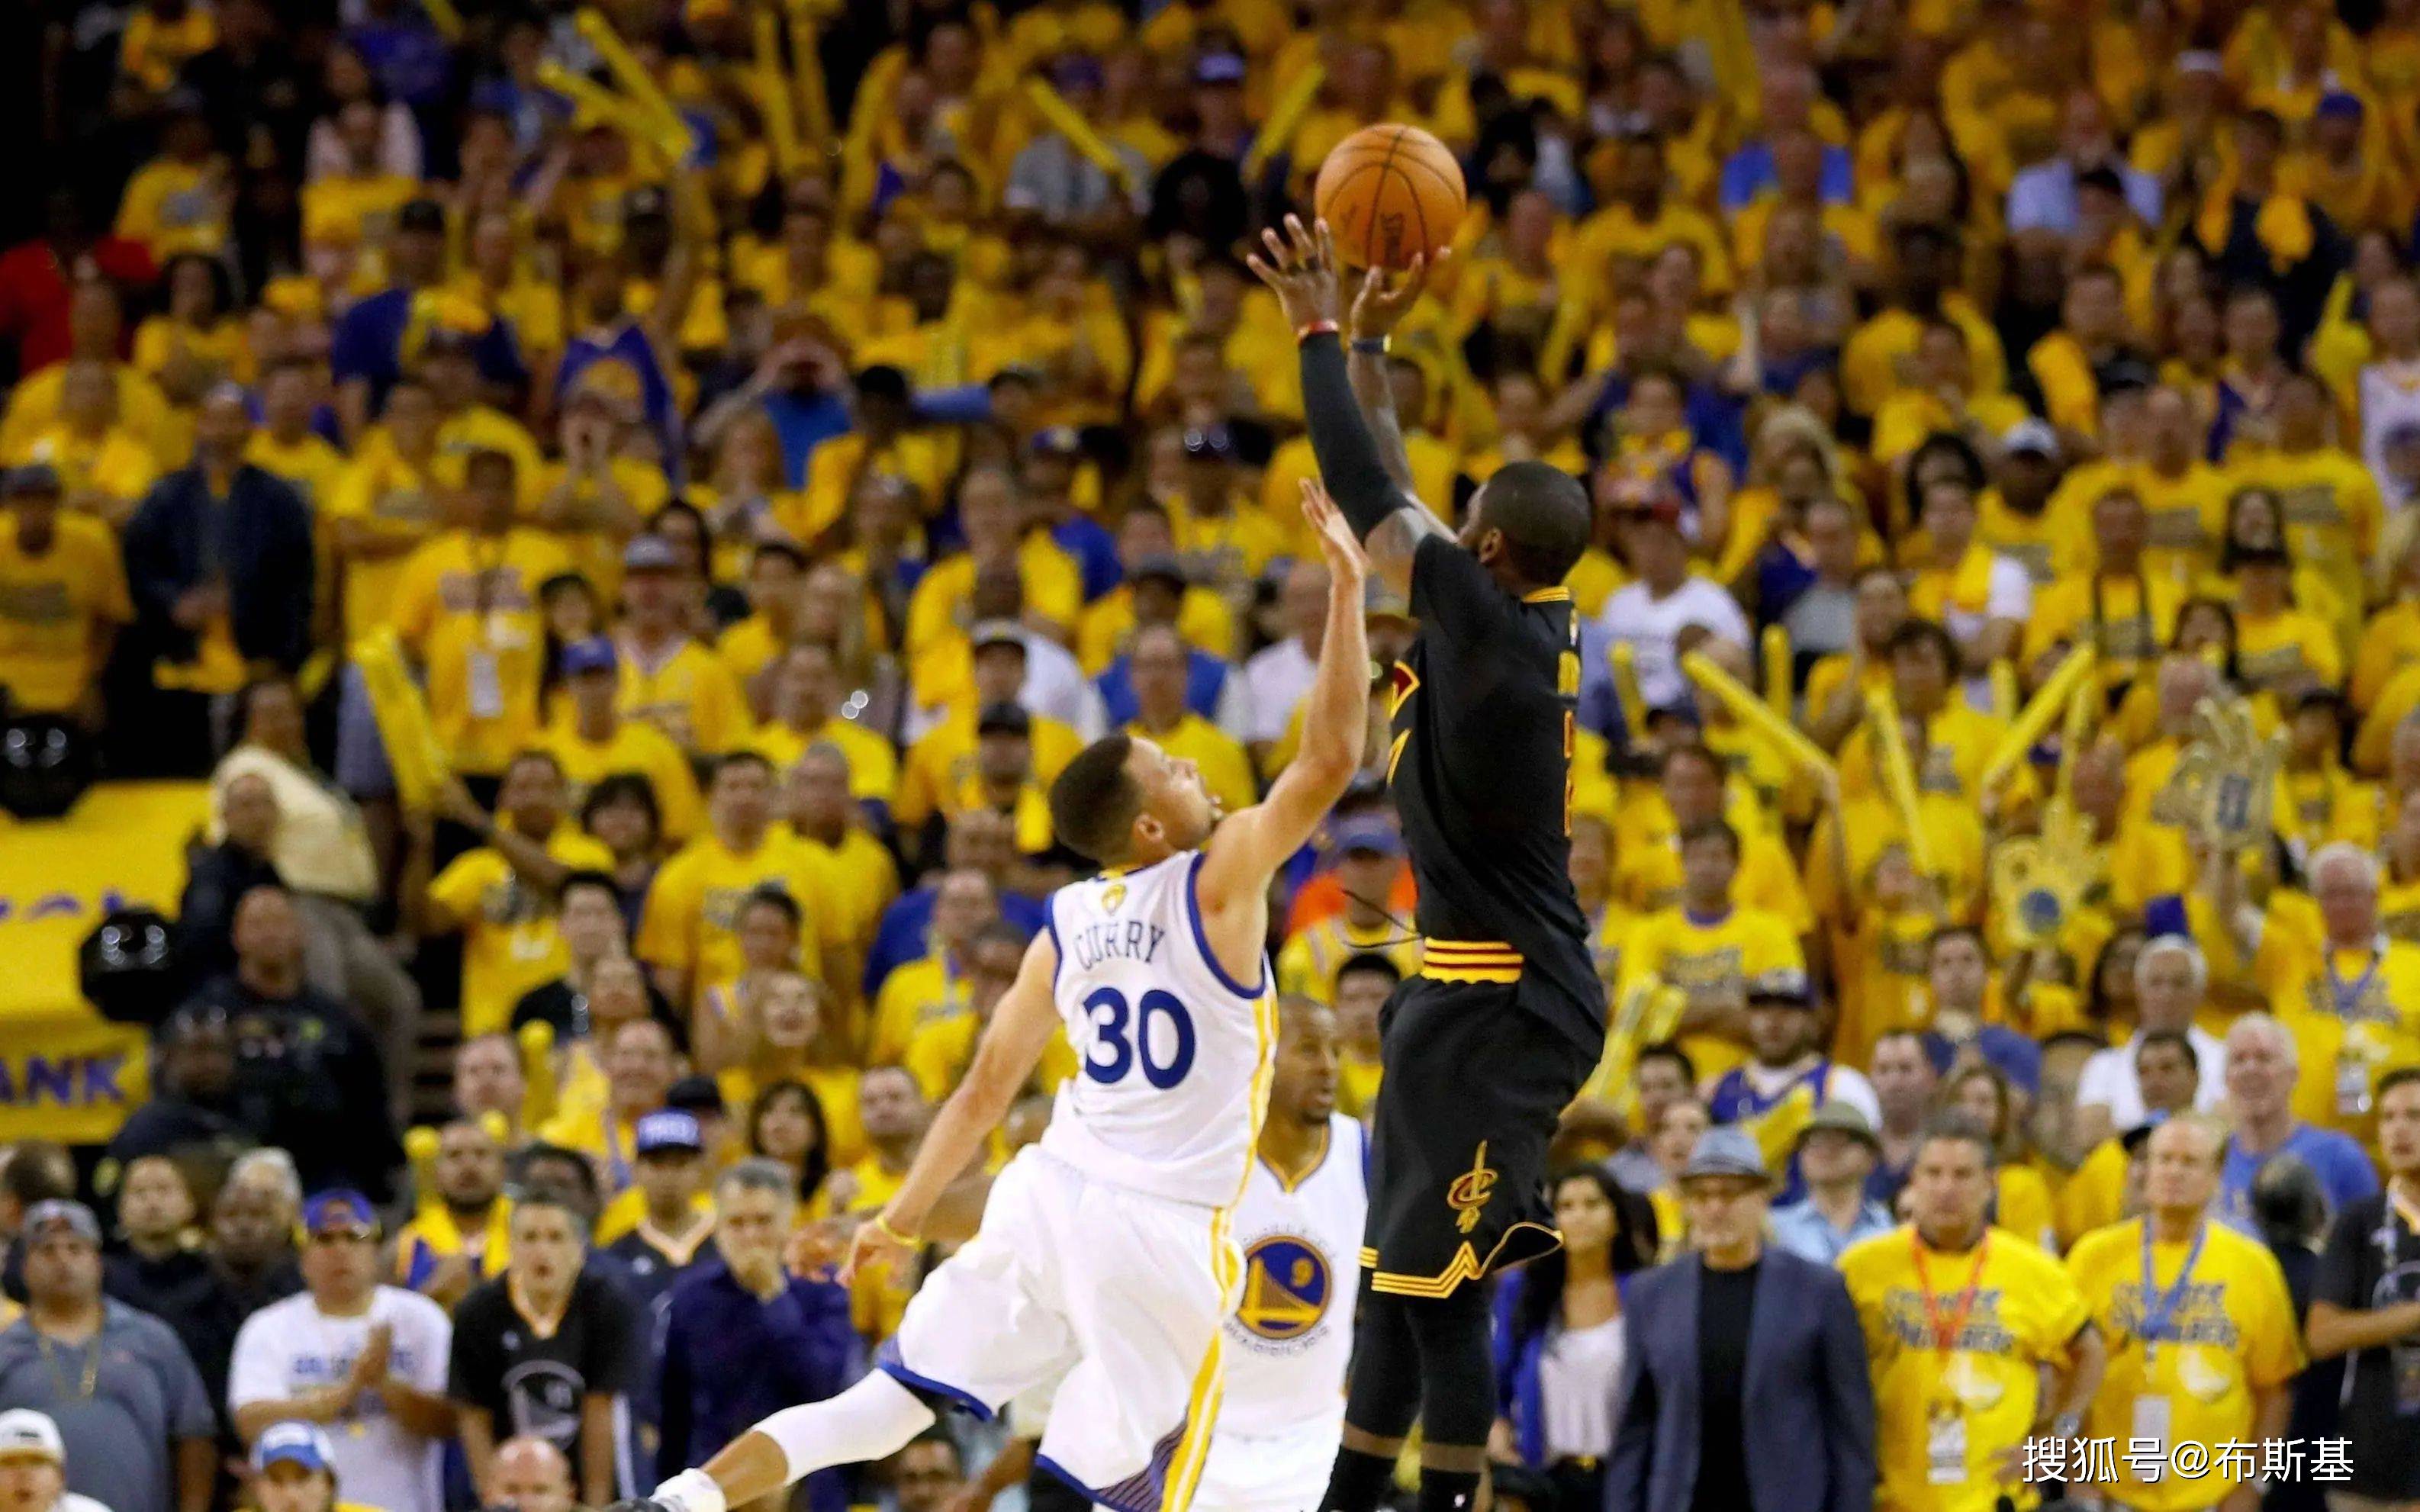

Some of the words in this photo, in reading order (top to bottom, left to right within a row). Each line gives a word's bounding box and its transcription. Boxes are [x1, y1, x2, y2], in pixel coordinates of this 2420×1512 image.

[1073, 920, 1165, 970] CURRY
[1083, 986, 1196, 1089] 30
[1291, 1257, 1315, 1288] 9
